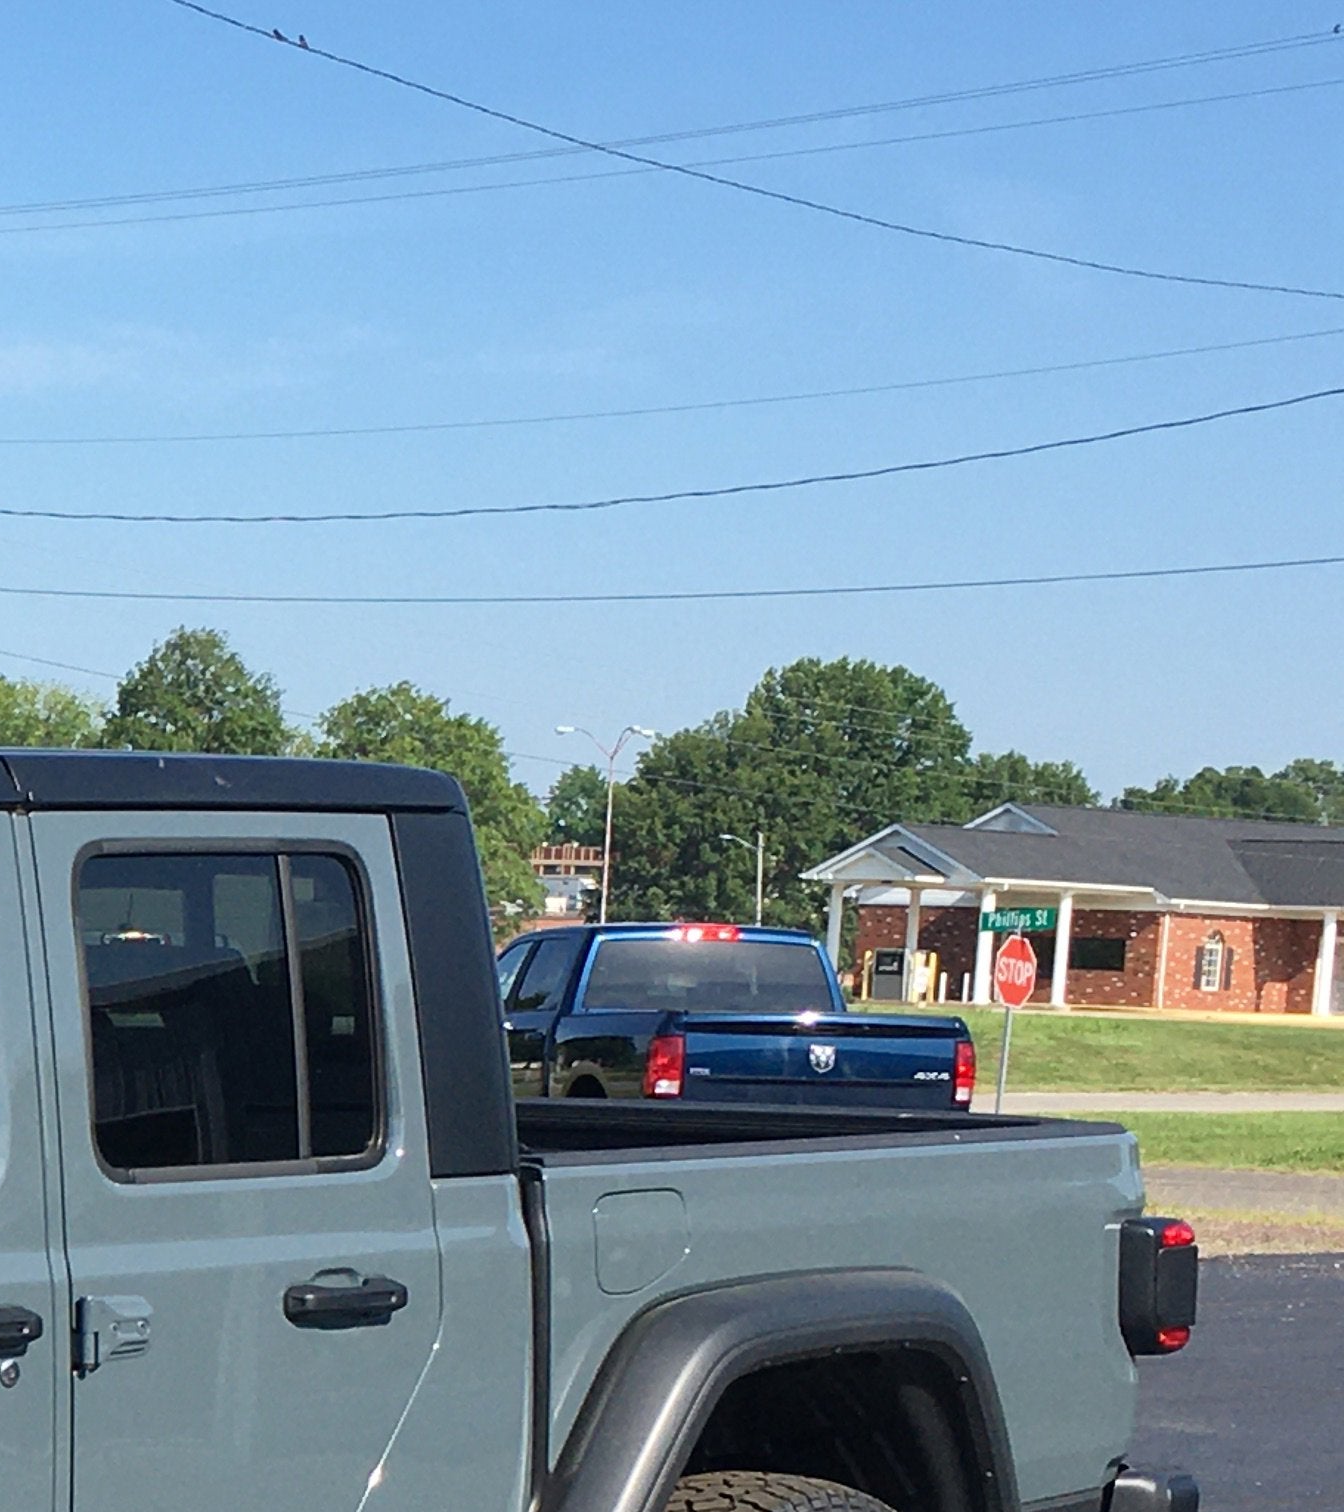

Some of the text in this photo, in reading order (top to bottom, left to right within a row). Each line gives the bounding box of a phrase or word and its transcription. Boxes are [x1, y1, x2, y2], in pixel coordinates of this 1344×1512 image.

[987, 909, 1048, 928] Phillips St
[997, 956, 1033, 987] STOP
